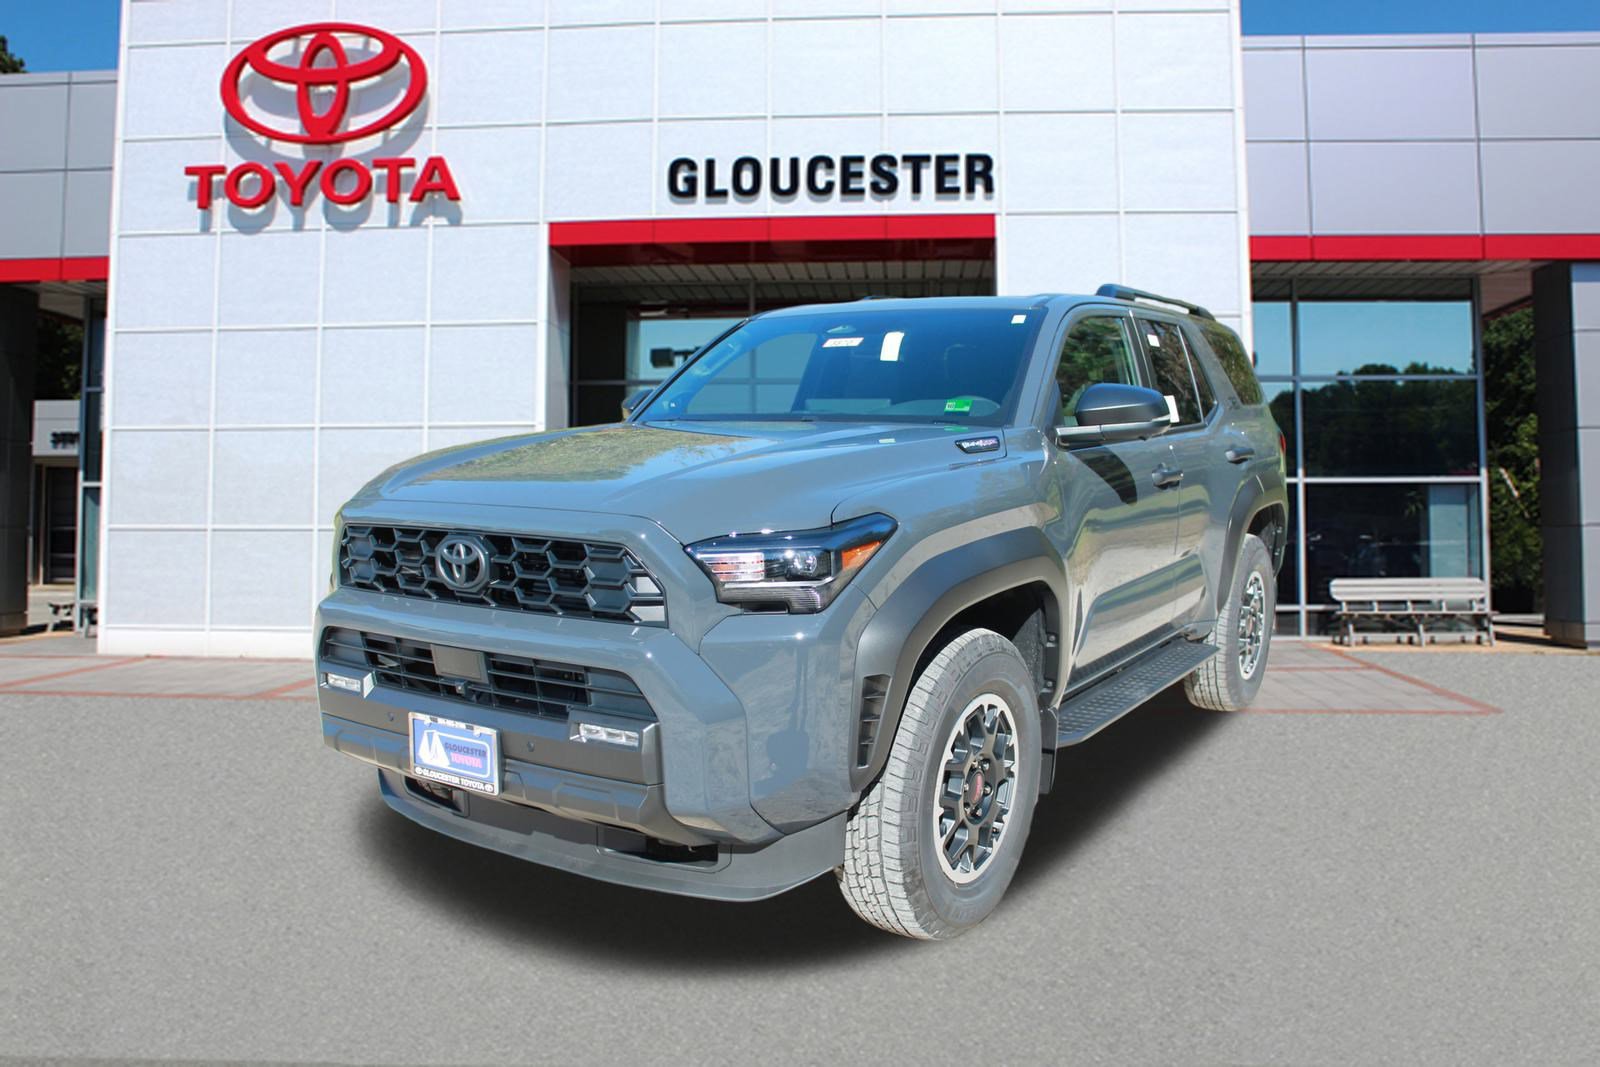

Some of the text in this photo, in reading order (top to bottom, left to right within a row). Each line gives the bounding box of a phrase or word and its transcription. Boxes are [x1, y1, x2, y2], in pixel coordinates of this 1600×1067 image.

[185, 156, 461, 210] TOYOTA
[668, 154, 995, 198] GLOUCESTER
[444, 742, 486, 757] GLOUCESTER
[451, 752, 483, 768] TOYOTA
[423, 769, 485, 790] GLOUCESTER TOYOTA
